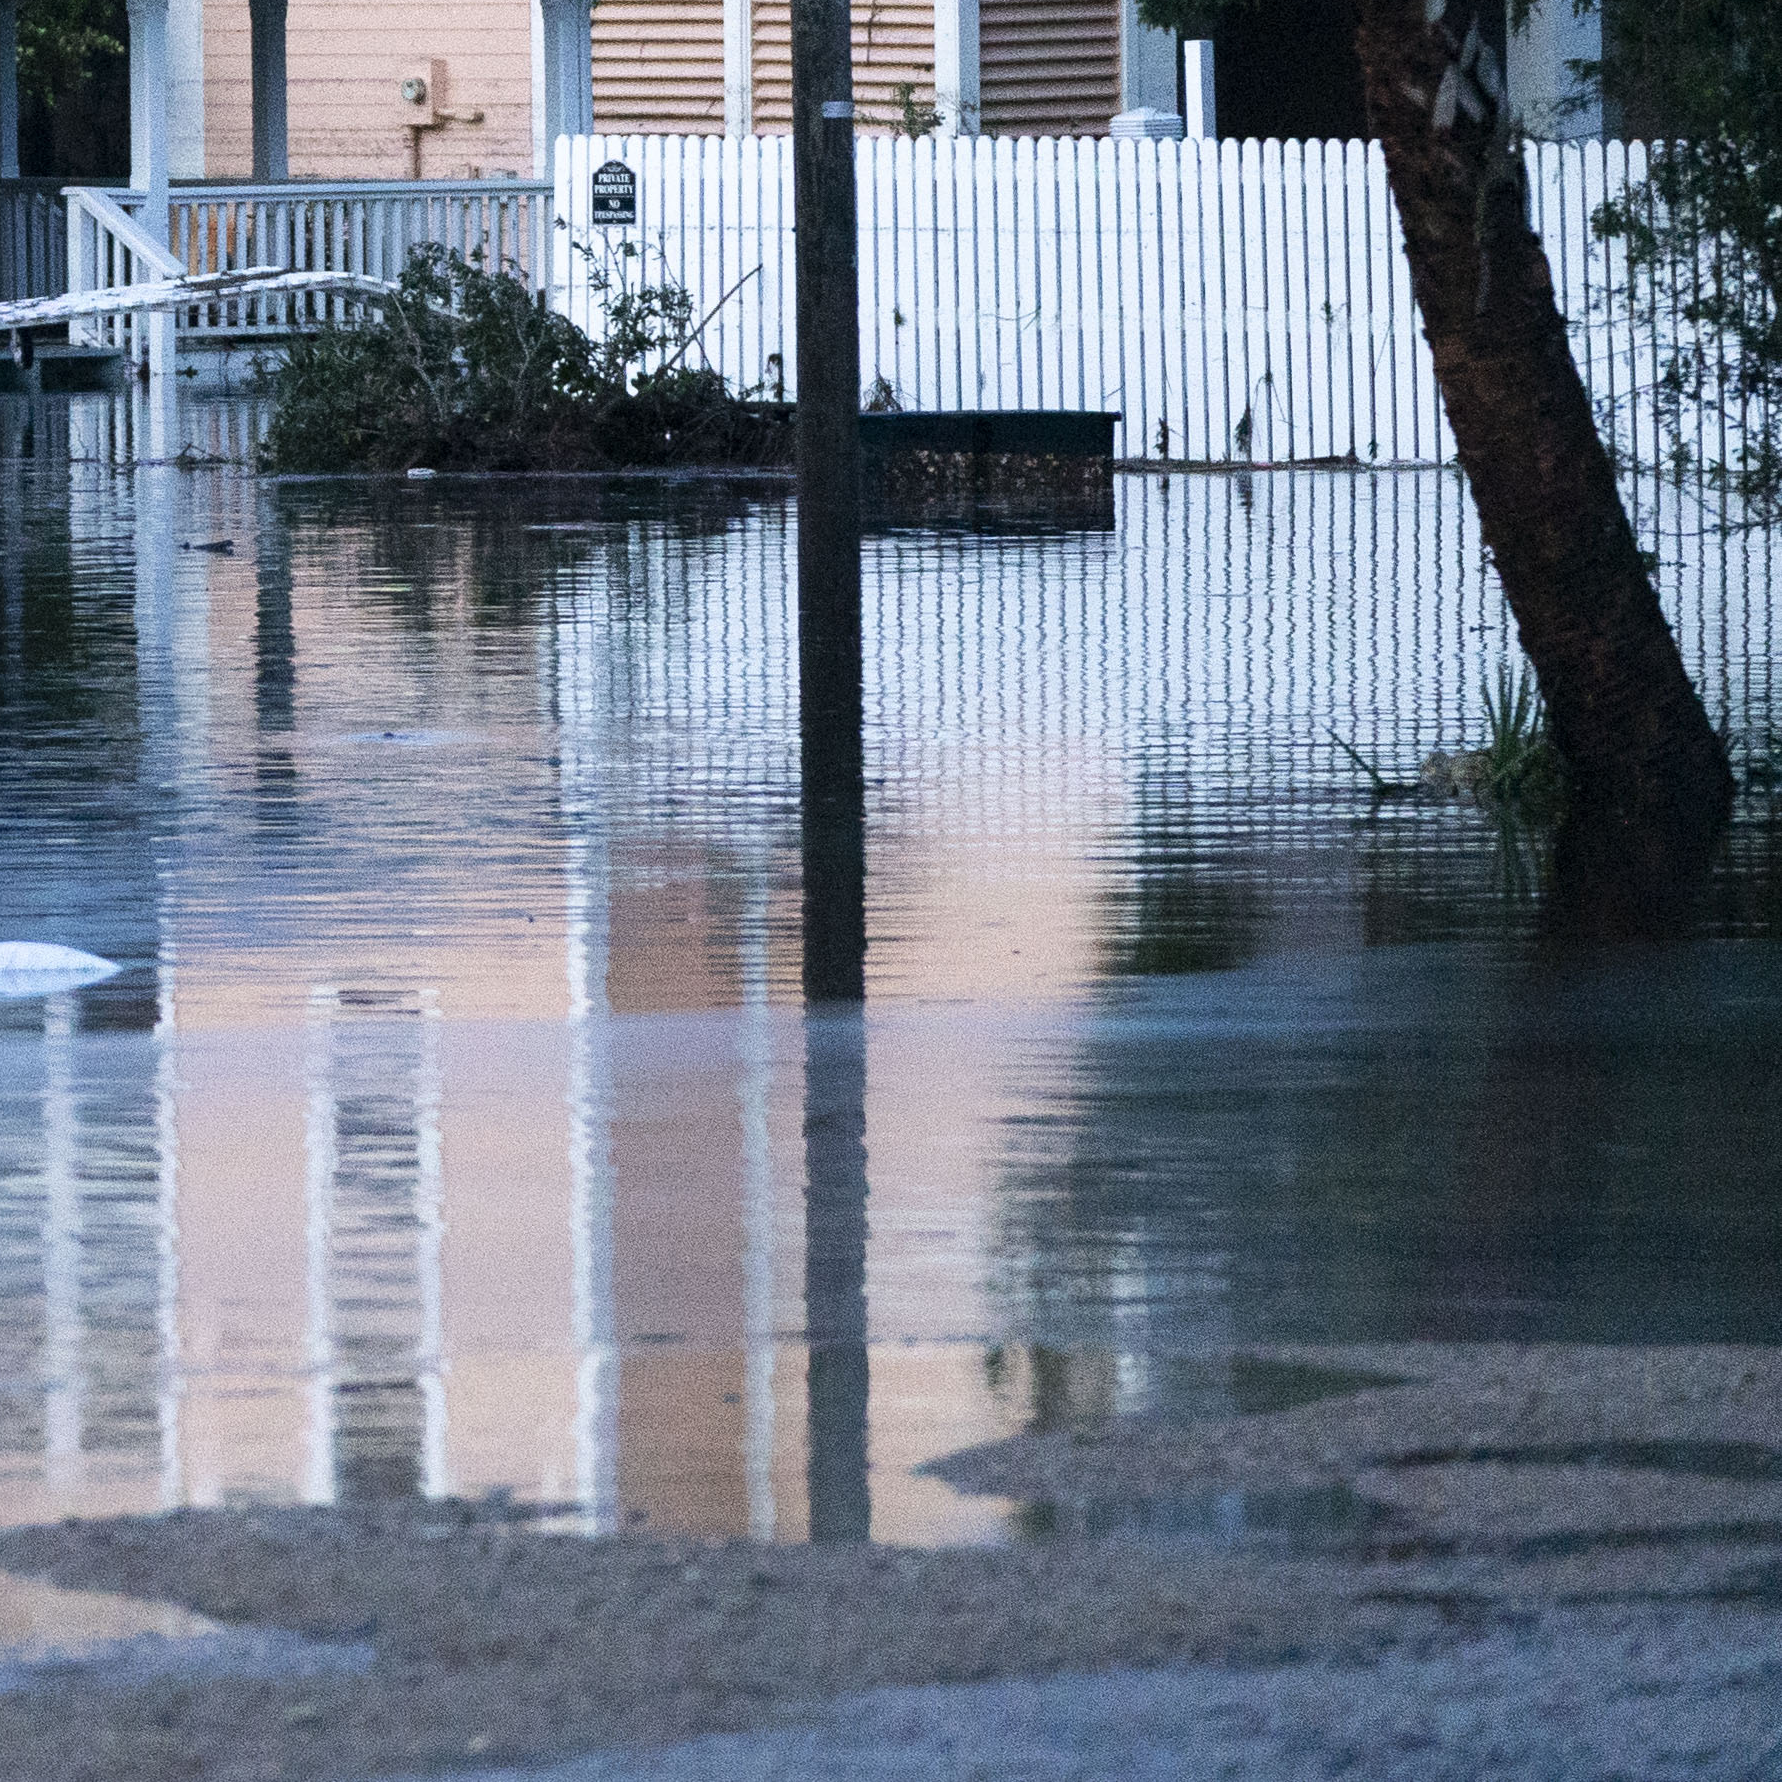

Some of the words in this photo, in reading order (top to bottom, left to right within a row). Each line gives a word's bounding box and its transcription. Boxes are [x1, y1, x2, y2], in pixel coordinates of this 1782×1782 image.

[597, 173, 631, 183] PRIVATE
[593, 184, 634, 194] PROPERTY
[608, 199, 621, 209] NO
